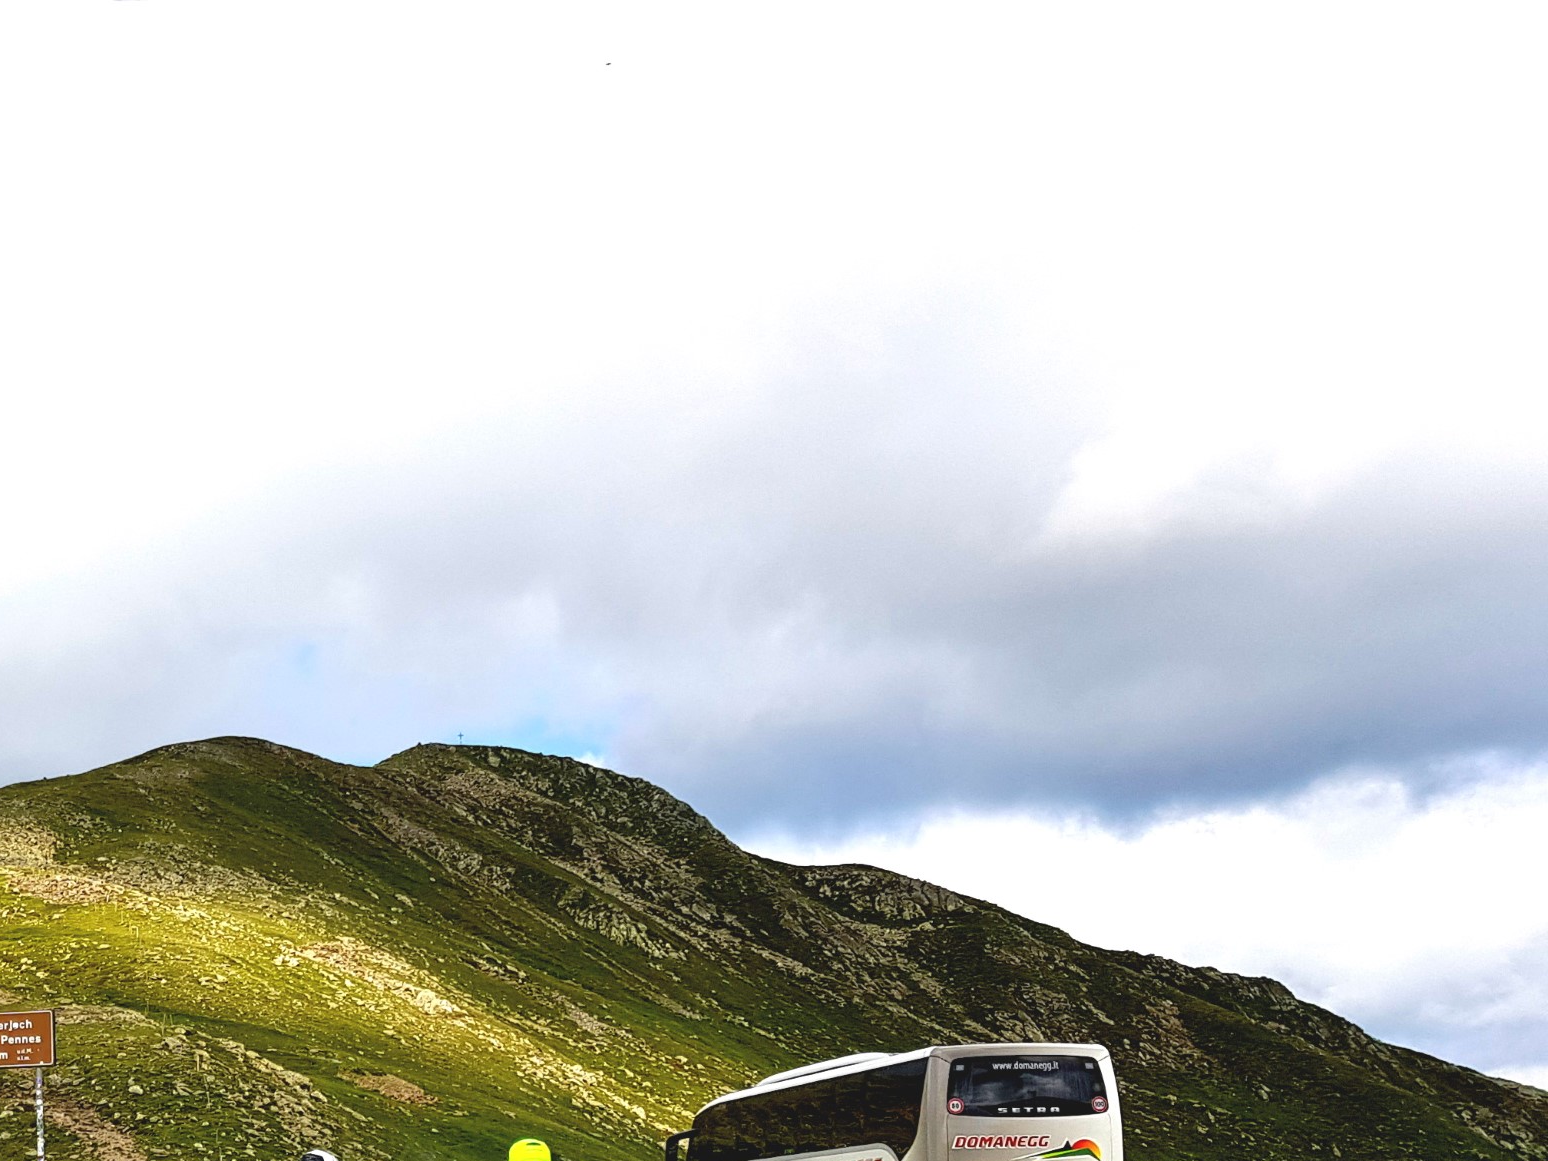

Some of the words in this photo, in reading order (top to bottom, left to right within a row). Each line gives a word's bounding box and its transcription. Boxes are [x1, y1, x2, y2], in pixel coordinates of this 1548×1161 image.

[1, 1035, 41, 1044] Pennes
[992, 1061, 1059, 1071] www.domanegg.it
[954, 1135, 1050, 1149] DOMANEGG
